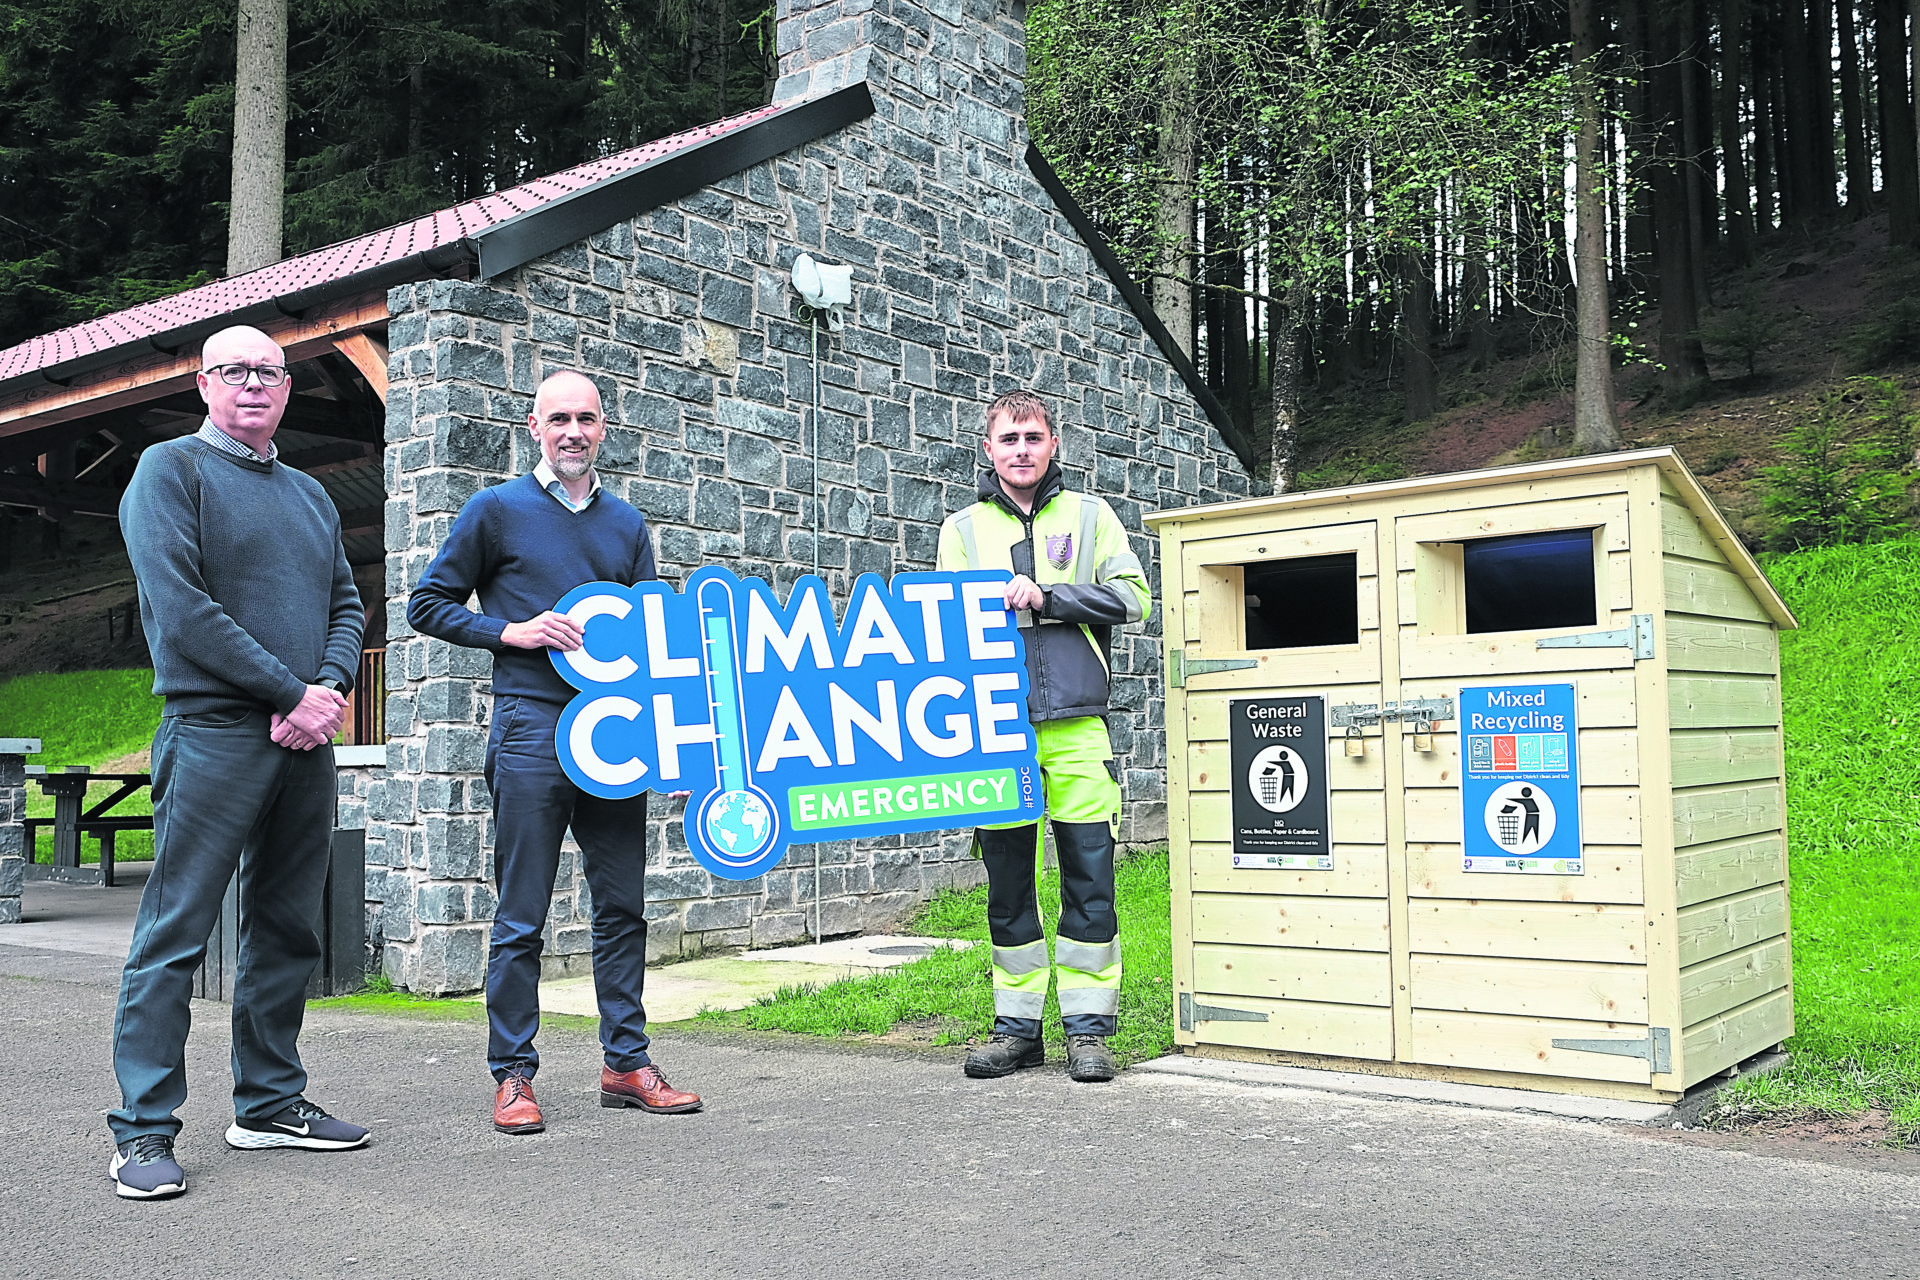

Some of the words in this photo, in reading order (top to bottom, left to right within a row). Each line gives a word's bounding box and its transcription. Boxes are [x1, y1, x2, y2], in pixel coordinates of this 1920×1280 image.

[565, 578, 1017, 684] CLIMATE
[1246, 702, 1307, 719] General
[1487, 689, 1545, 707] Mixed
[568, 672, 1027, 786] CHANGE
[1251, 723, 1302, 738] Waste
[1471, 711, 1565, 732] Recycling
[797, 775, 1008, 822] EMERGENCY
[1020, 766, 1035, 809] #FODC
